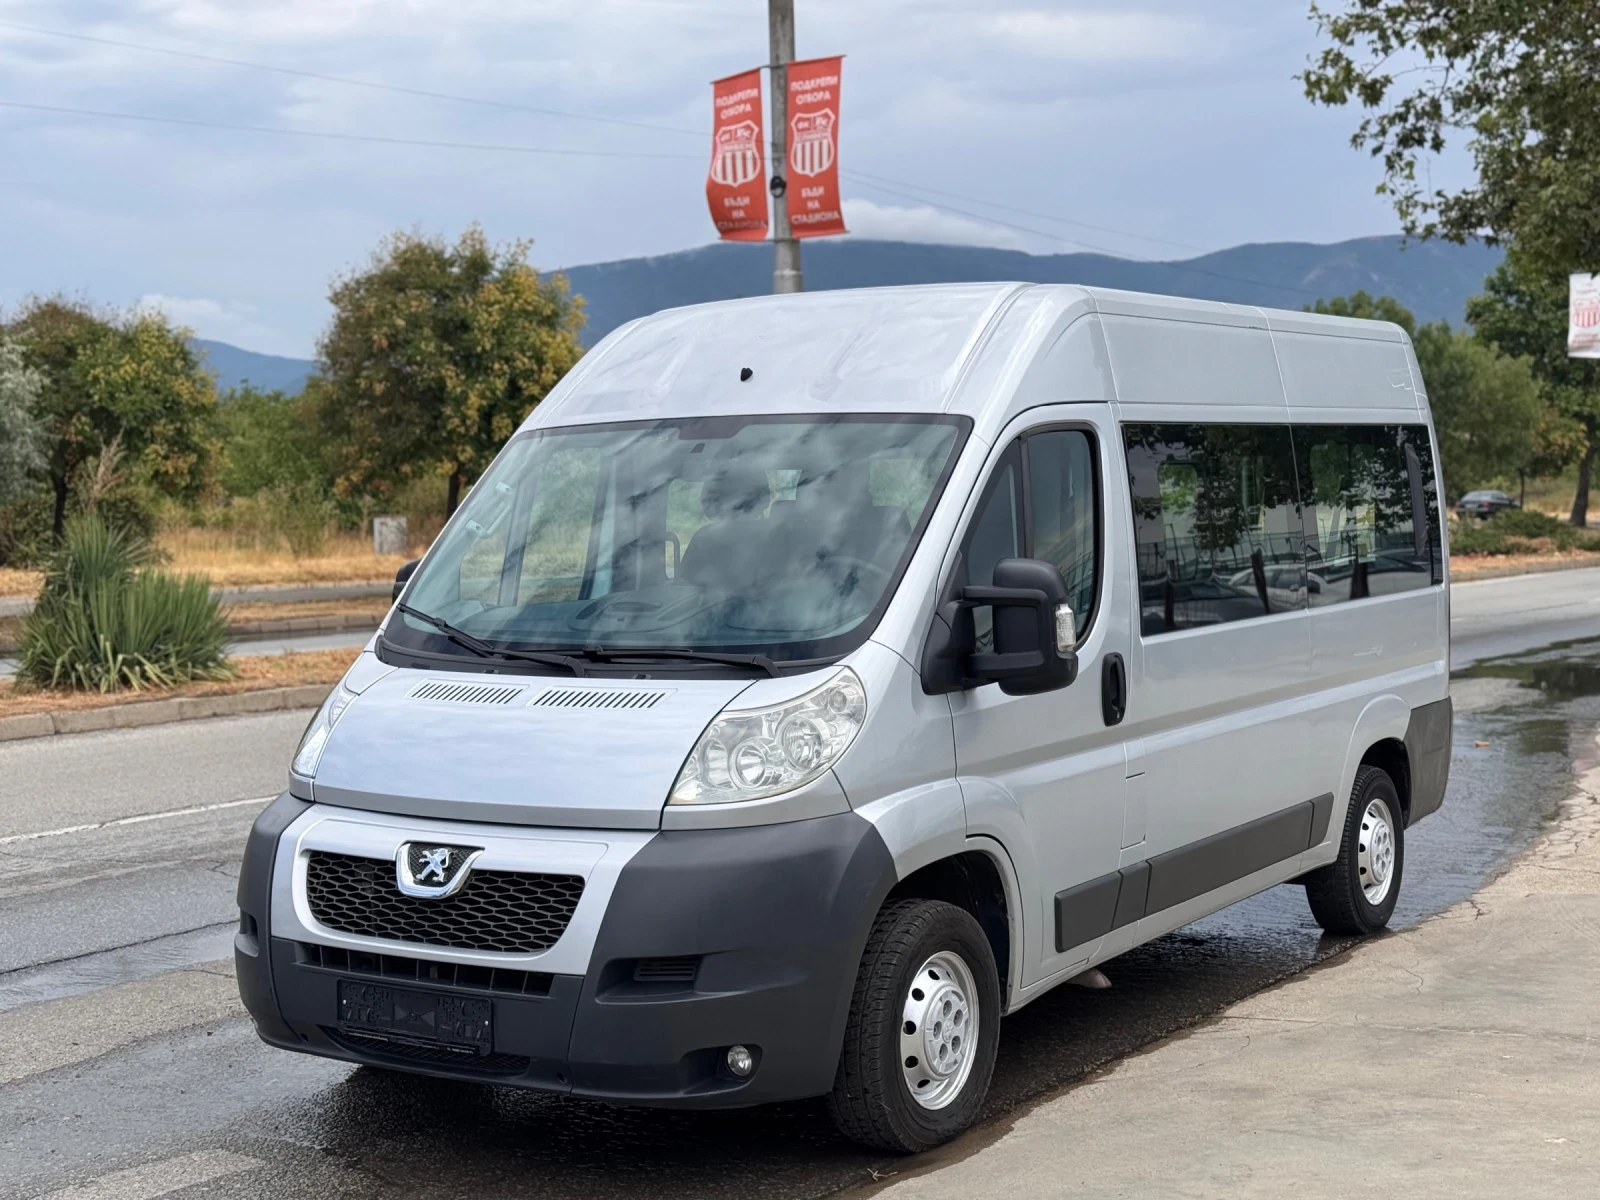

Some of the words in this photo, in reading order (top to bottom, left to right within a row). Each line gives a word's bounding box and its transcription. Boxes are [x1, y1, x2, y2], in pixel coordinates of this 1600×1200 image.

[791, 75, 838, 91] ПОДКРЕПИ
[795, 91, 831, 104] ОТБОРА
[806, 200, 820, 209] НА
[731, 209, 745, 219] НА
